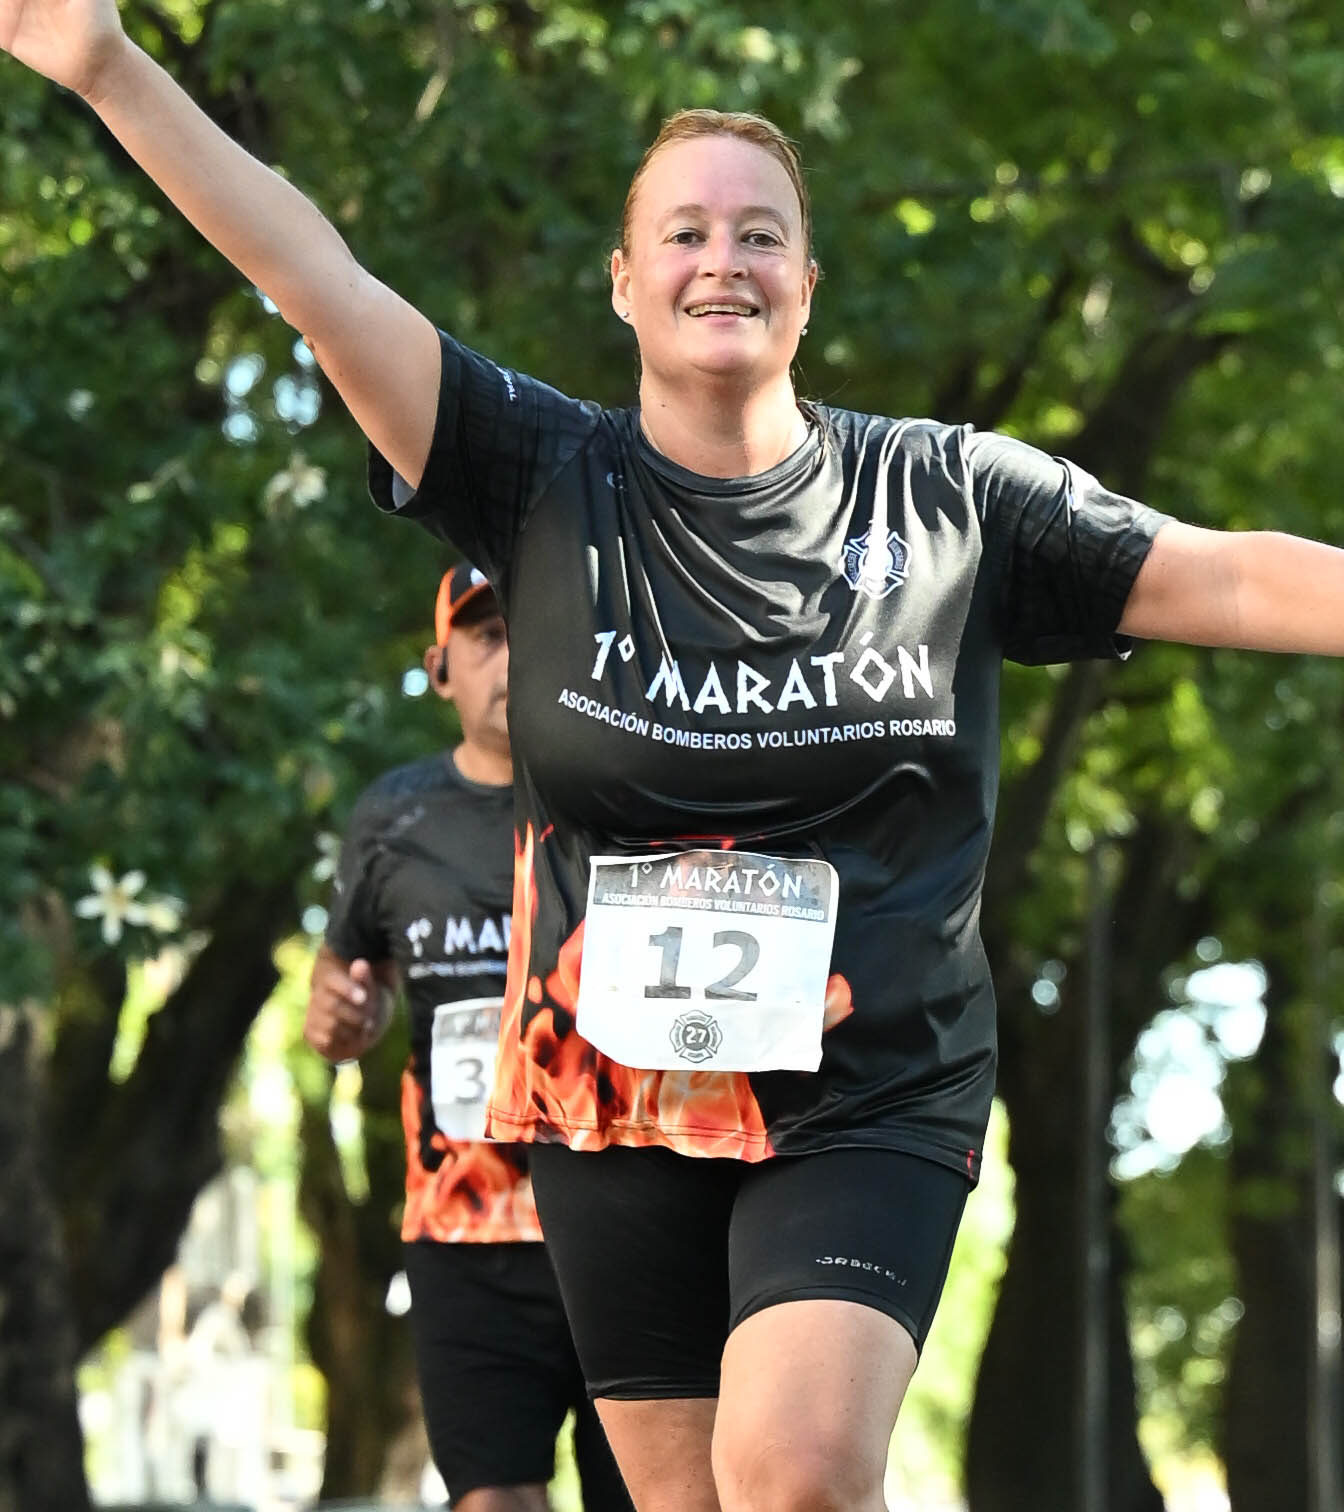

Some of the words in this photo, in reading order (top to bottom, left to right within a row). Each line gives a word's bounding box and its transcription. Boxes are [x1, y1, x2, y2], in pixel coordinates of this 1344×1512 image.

[645, 631, 934, 715] MARATÓN
[558, 688, 650, 737] ASOCIACIÓN
[651, 724, 752, 751] BOMBEROS
[757, 724, 886, 748] VOLUNTARIOS
[889, 719, 957, 738] ROSARIO
[660, 863, 803, 899] MARATÓN
[660, 895, 712, 910] BOMBEROS
[714, 898, 779, 916] VOLUNTARIOS
[781, 905, 825, 921] ROSARIO
[444, 914, 512, 955] MA
[644, 926, 760, 1001] 12
[685, 1025, 707, 1044] 27
